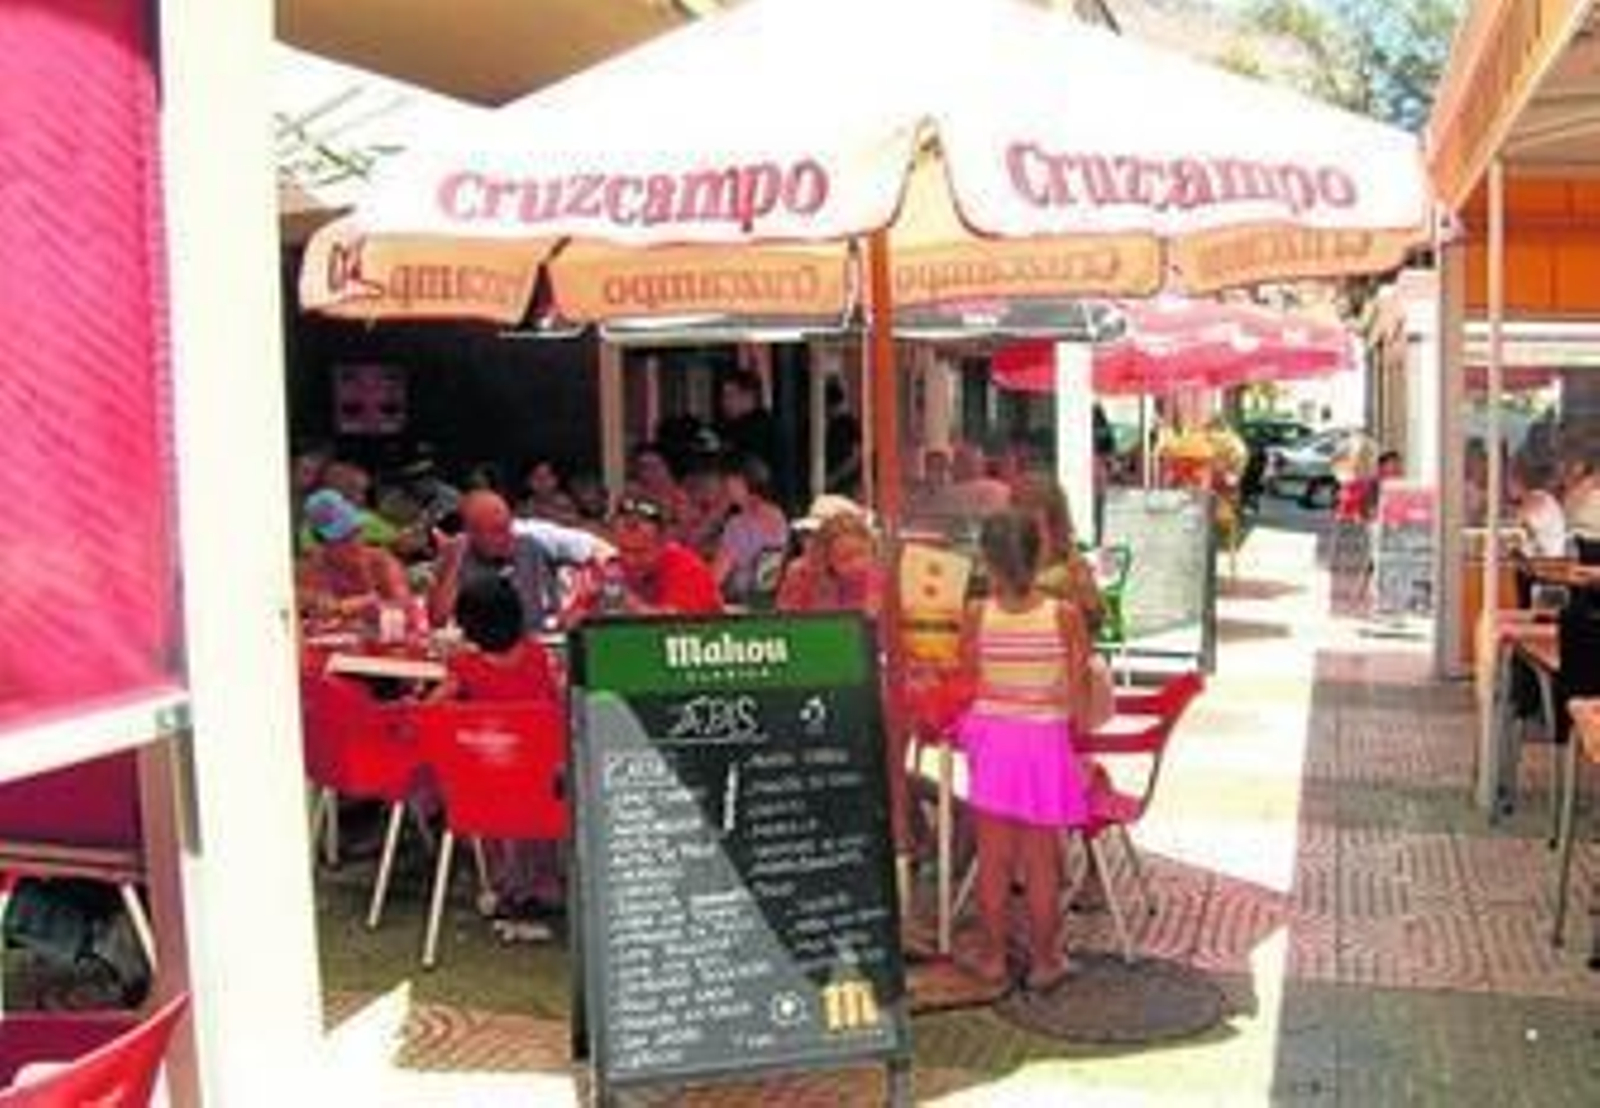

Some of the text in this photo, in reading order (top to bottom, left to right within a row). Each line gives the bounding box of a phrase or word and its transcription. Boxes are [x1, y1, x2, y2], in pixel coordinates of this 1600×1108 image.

[437, 158, 829, 231] Cruzcampo
[1006, 142, 1358, 212] Cruzcampo
[665, 633, 788, 668] Mahou
